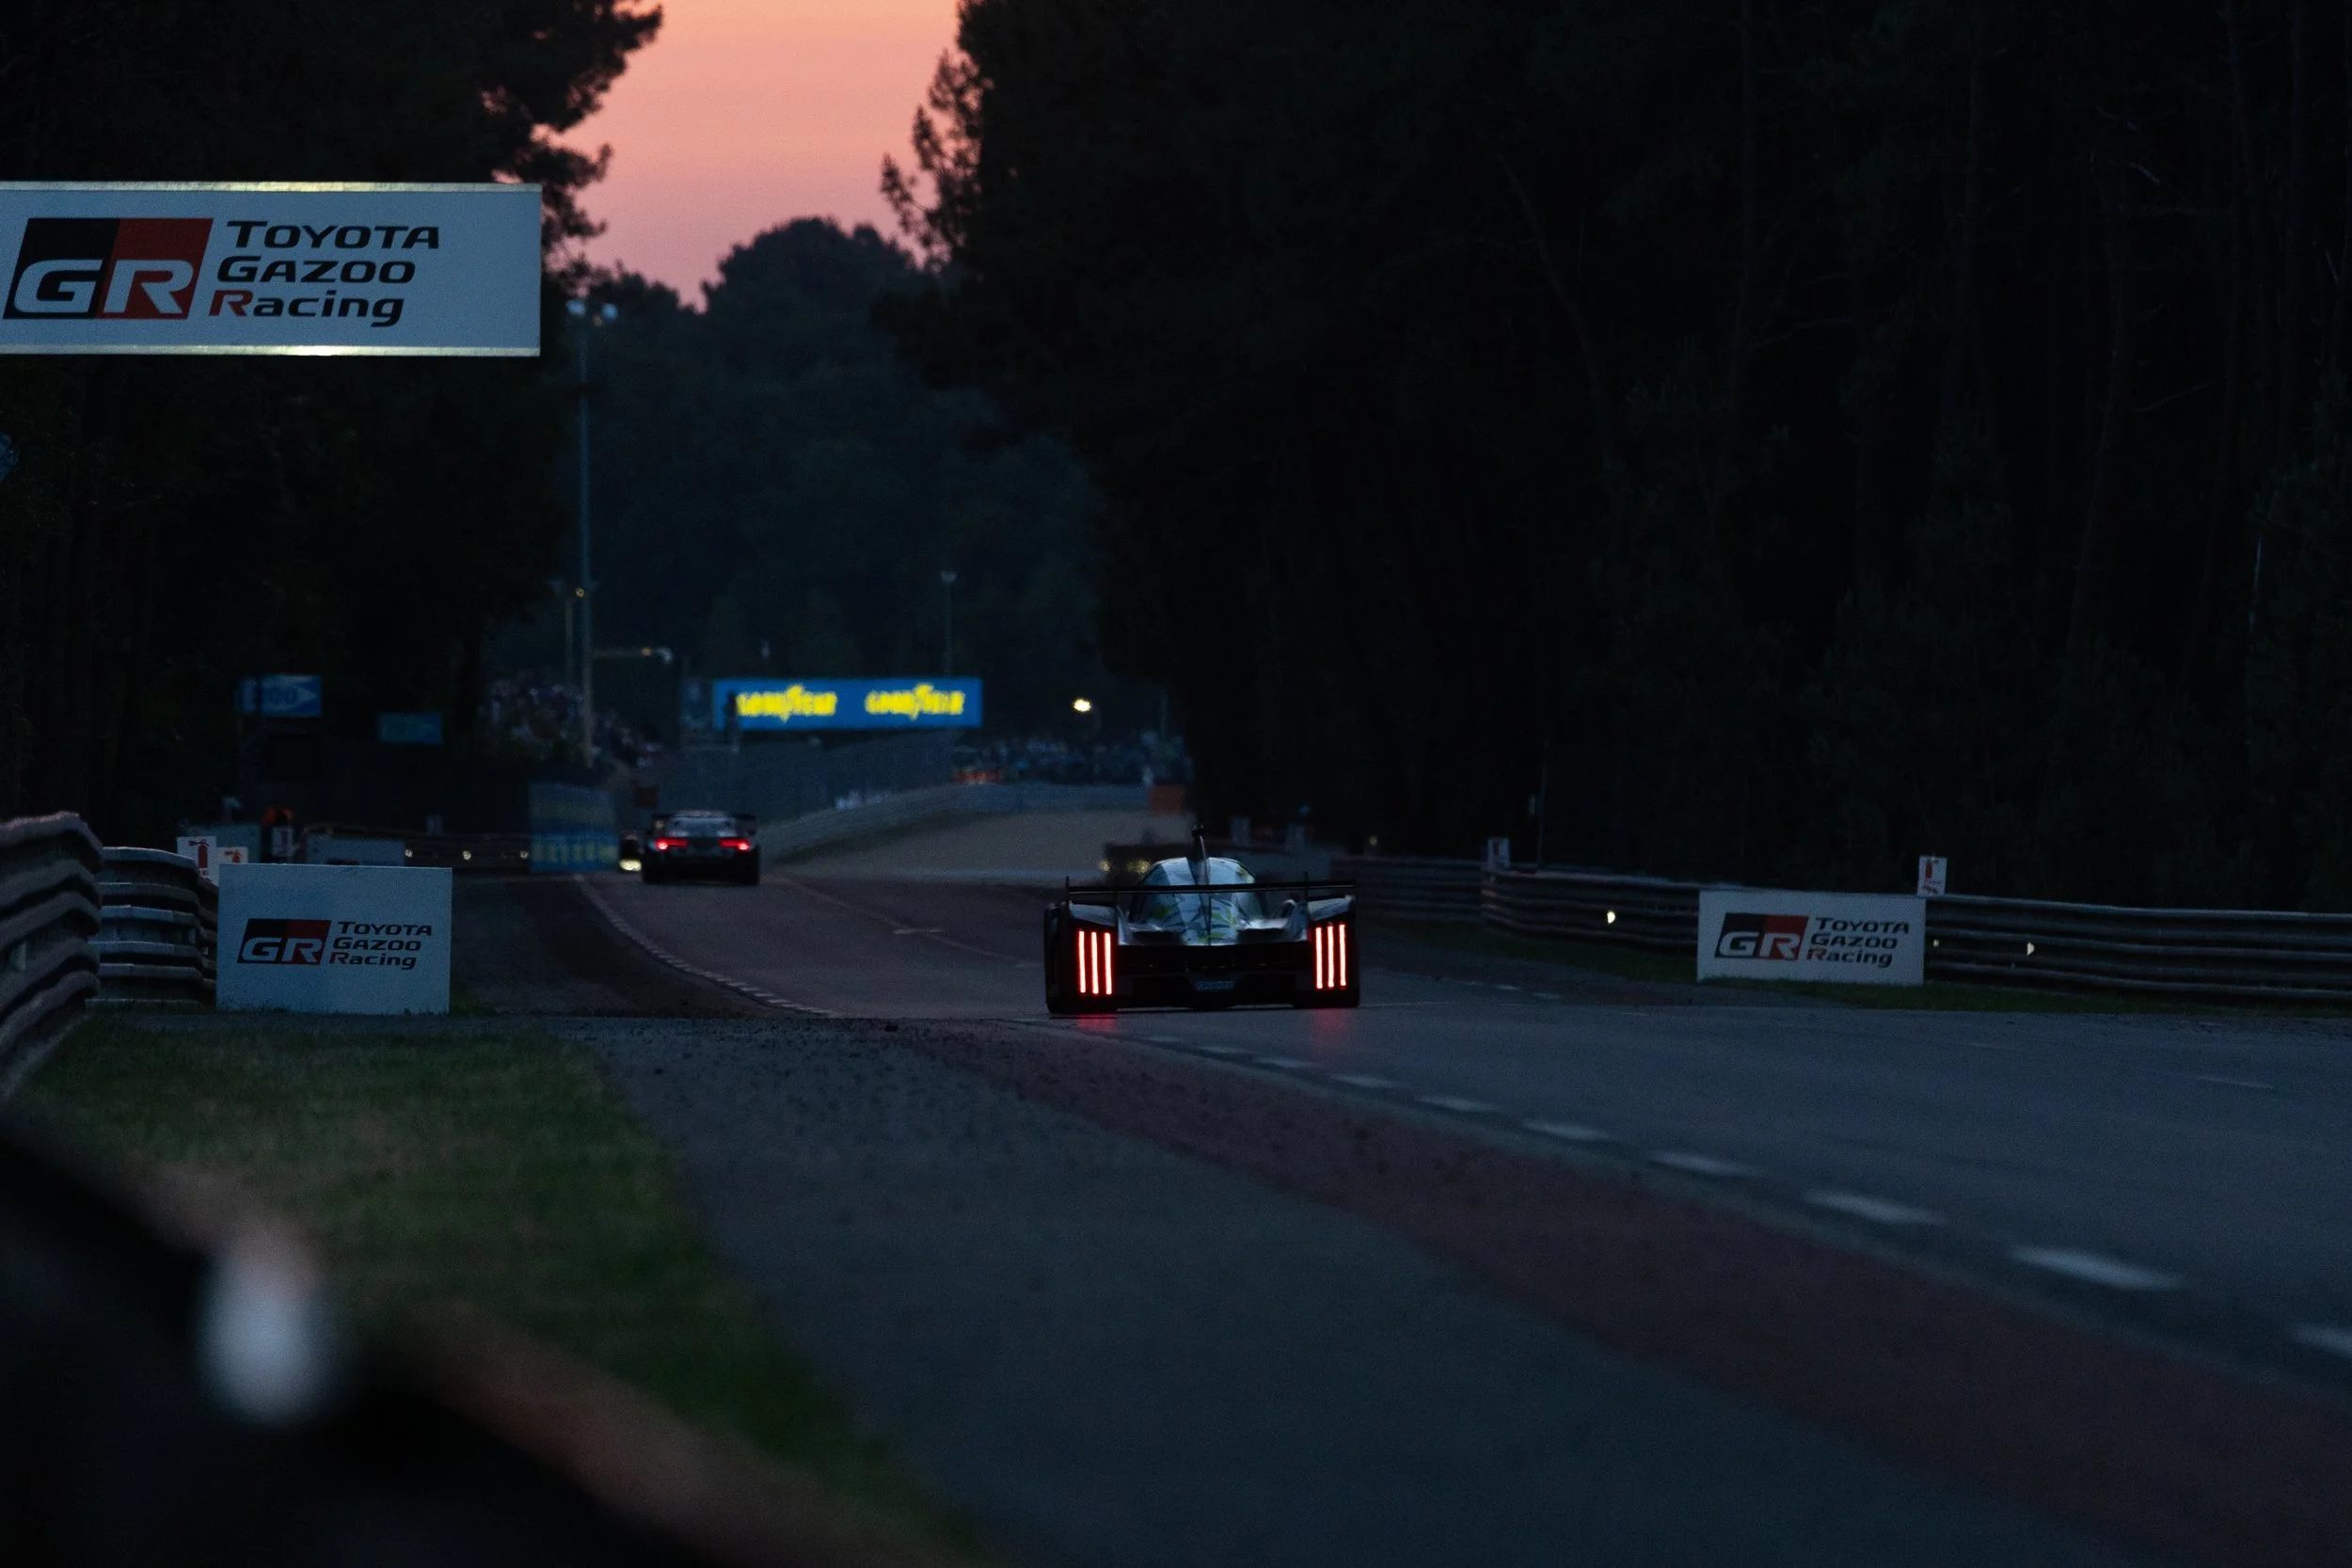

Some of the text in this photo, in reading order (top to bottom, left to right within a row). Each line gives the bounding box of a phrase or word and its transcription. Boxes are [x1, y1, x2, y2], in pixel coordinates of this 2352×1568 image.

[227, 220, 439, 249] TOYOTA
[217, 256, 416, 283] GAZOO
[13, 258, 193, 314] GR
[208, 290, 405, 327] Racing
[338, 922, 432, 936] TOYOTA
[1817, 917, 1910, 934] TOYOTA
[244, 938, 323, 962] GR
[334, 938, 421, 951] GAZOO
[1719, 932, 1800, 958] GR
[1812, 933, 1898, 949] GAZOO
[329, 953, 417, 970] Racing
[1807, 948, 1893, 967] Racing
